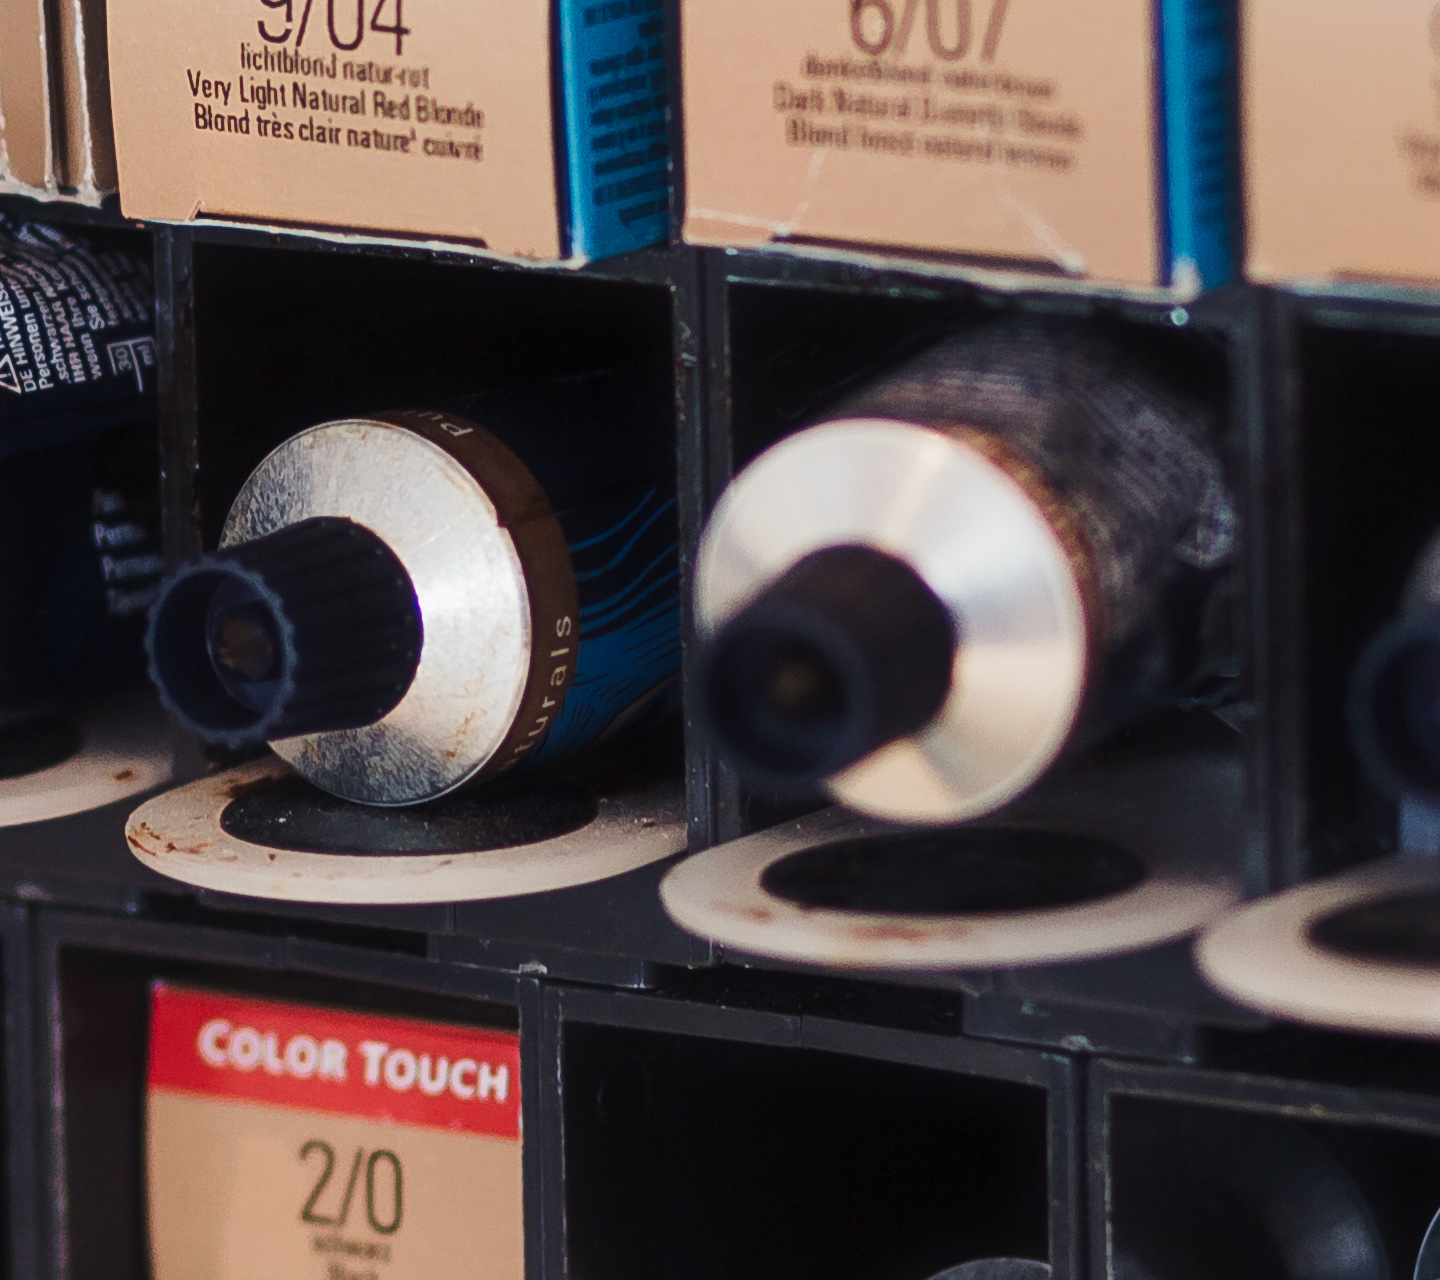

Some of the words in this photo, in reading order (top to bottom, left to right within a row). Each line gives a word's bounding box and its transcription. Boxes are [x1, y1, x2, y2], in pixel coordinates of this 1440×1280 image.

[186, 68, 233, 105] Very
[238, 74, 287, 112] Light
[292, 85, 367, 118] Natural
[256, 111, 294, 142] très
[298, 114, 342, 147] clair
[24, 312, 55, 390] Personen
[68, 351, 86, 383] IHR
[20, 368, 38, 393] DE
[197, 1018, 348, 1082] COLOR
[358, 1039, 511, 1105] TOUCH
[298, 1139, 405, 1237] 2/0
